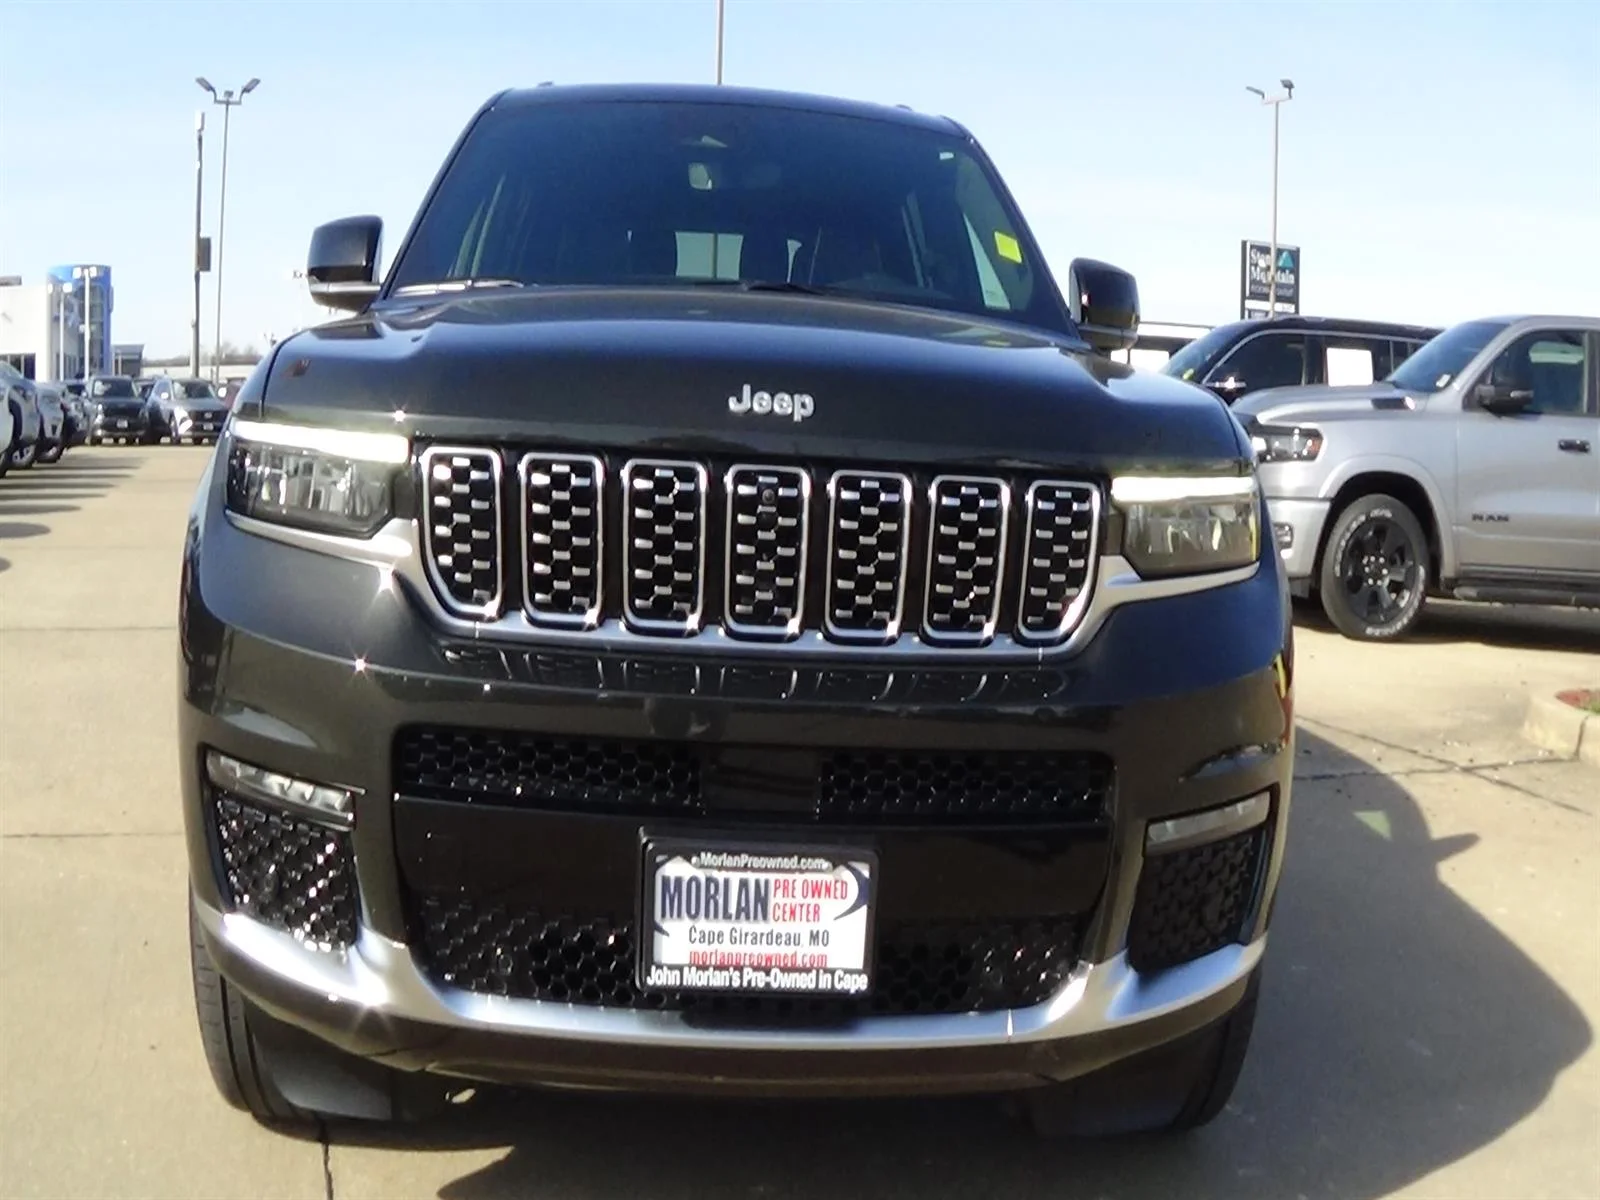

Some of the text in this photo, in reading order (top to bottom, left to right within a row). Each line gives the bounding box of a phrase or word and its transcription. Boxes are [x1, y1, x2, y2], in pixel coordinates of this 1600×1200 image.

[1251, 248, 1272, 264] Ston
[728, 383, 814, 422] Jeep
[1471, 513, 1509, 522] RAM
[661, 875, 770, 921] MORLAN
[773, 878, 848, 900] PRE OWNED
[772, 903, 821, 922] CENTER
[688, 927, 830, 947] Cape Girardeau, MO
[646, 966, 868, 993] John Morlan's Pre-Owned in Cape
